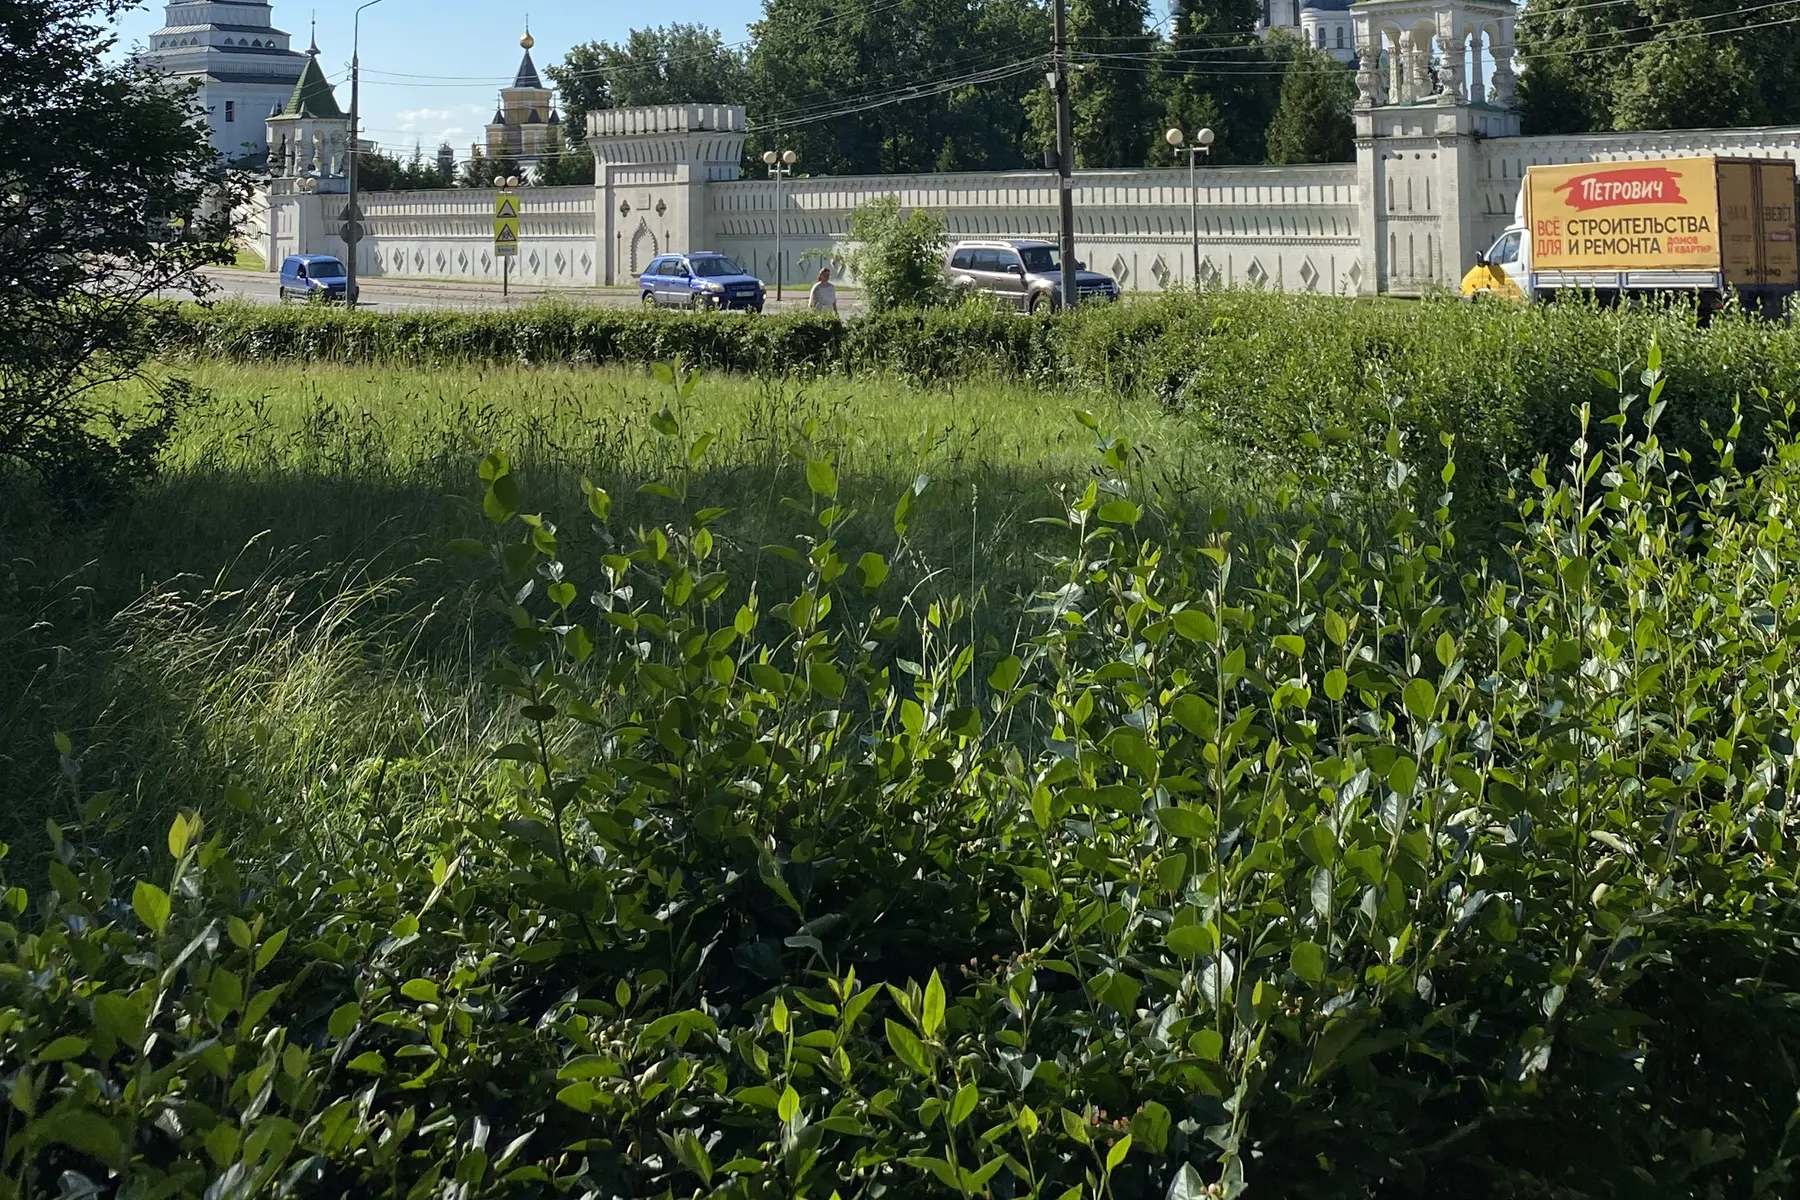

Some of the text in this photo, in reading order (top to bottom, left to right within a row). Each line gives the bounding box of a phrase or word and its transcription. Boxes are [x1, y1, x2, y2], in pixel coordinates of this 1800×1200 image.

[1581, 178, 1663, 201] ПЕТРОВИЧ
[1537, 216, 1561, 236] ВСЁ
[1567, 216, 1711, 236] СТРОИТЕЛЬСТВА
[1536, 239, 1562, 258] ДЛЯ
[1569, 237, 1662, 255] И РЕМОНТА
[1667, 236, 1698, 245] ДОМОВ
[1674, 244, 1712, 254] КВАРТИР
